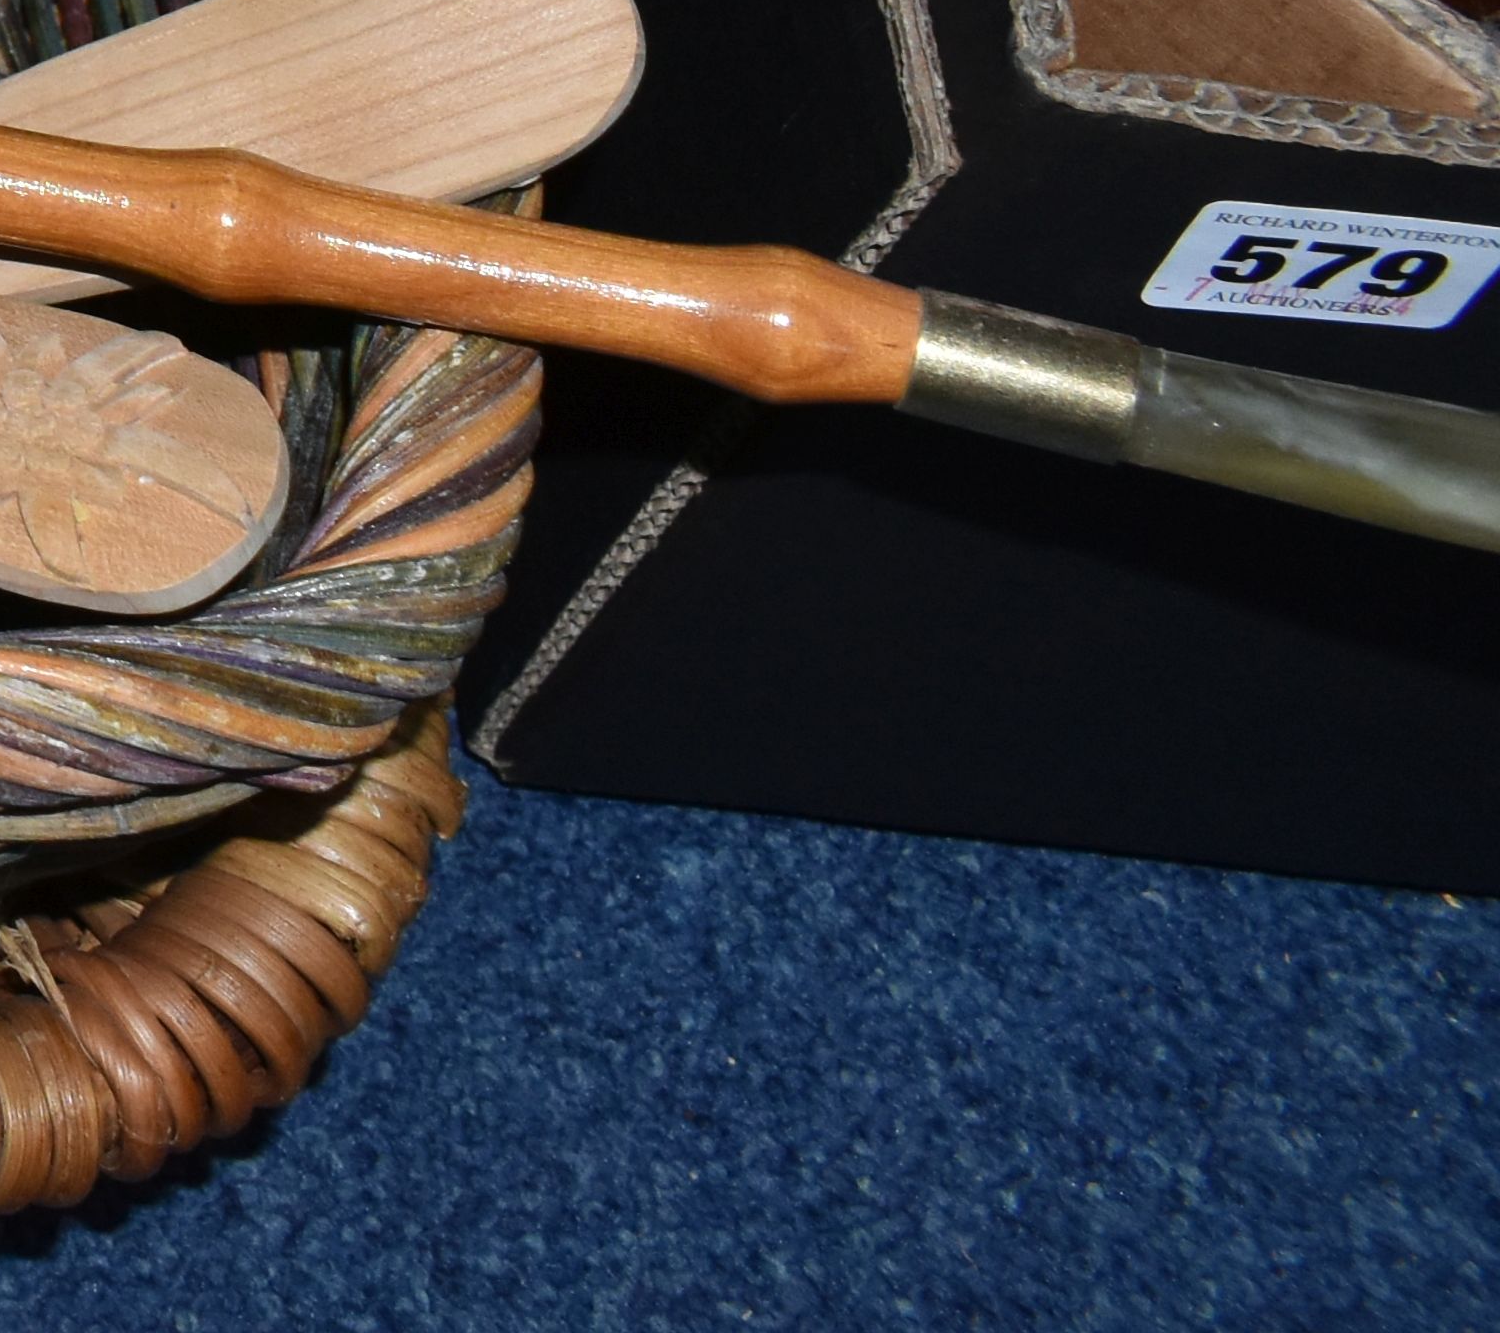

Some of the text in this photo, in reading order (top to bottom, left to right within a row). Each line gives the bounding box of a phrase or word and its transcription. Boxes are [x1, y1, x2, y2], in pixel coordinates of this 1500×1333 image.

[1213, 212, 1500, 249] RICHARD WINTERTON
[1210, 234, 1449, 298] 579
[1206, 291, 1393, 317] AUCTIONEERS
